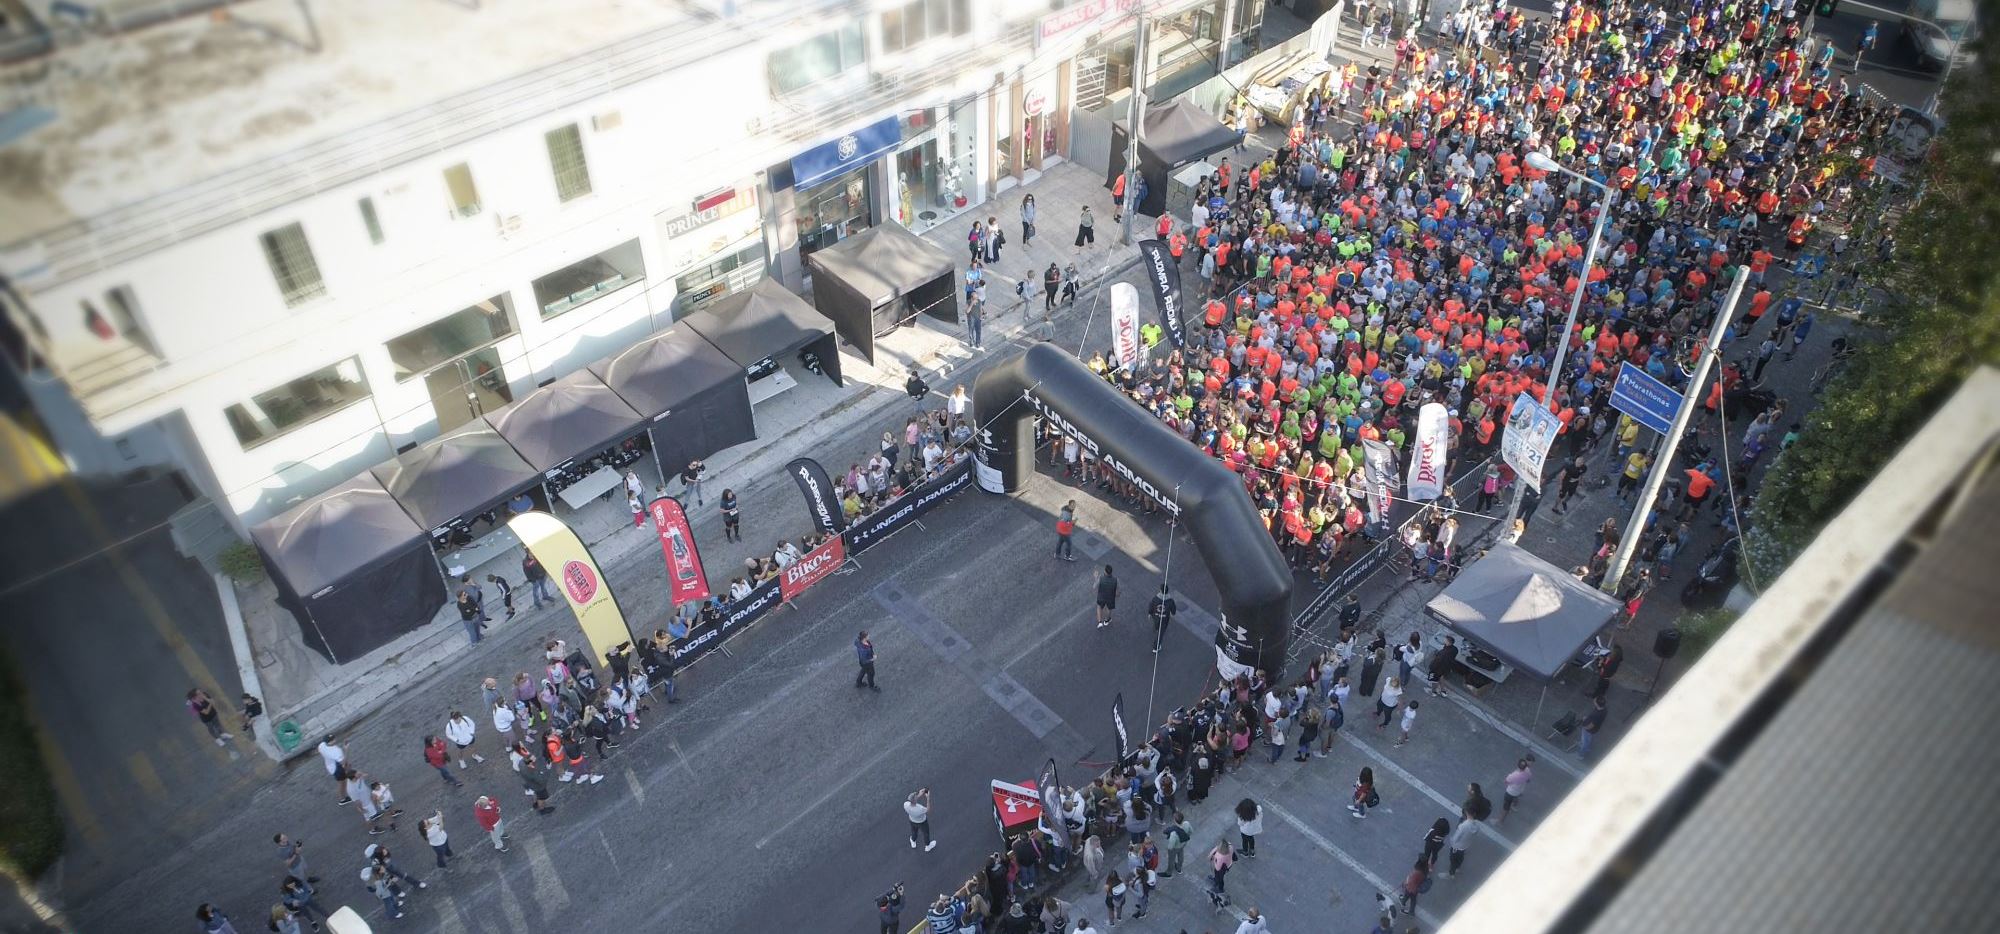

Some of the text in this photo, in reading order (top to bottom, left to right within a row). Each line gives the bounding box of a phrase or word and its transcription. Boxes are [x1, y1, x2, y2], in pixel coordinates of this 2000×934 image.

[667, 207, 719, 238] PRINCE
[1628, 380, 1670, 408] Marathonas
[1044, 405, 1180, 517] UNDER ARMOUR
[870, 472, 969, 534] UNDER ARMOUR
